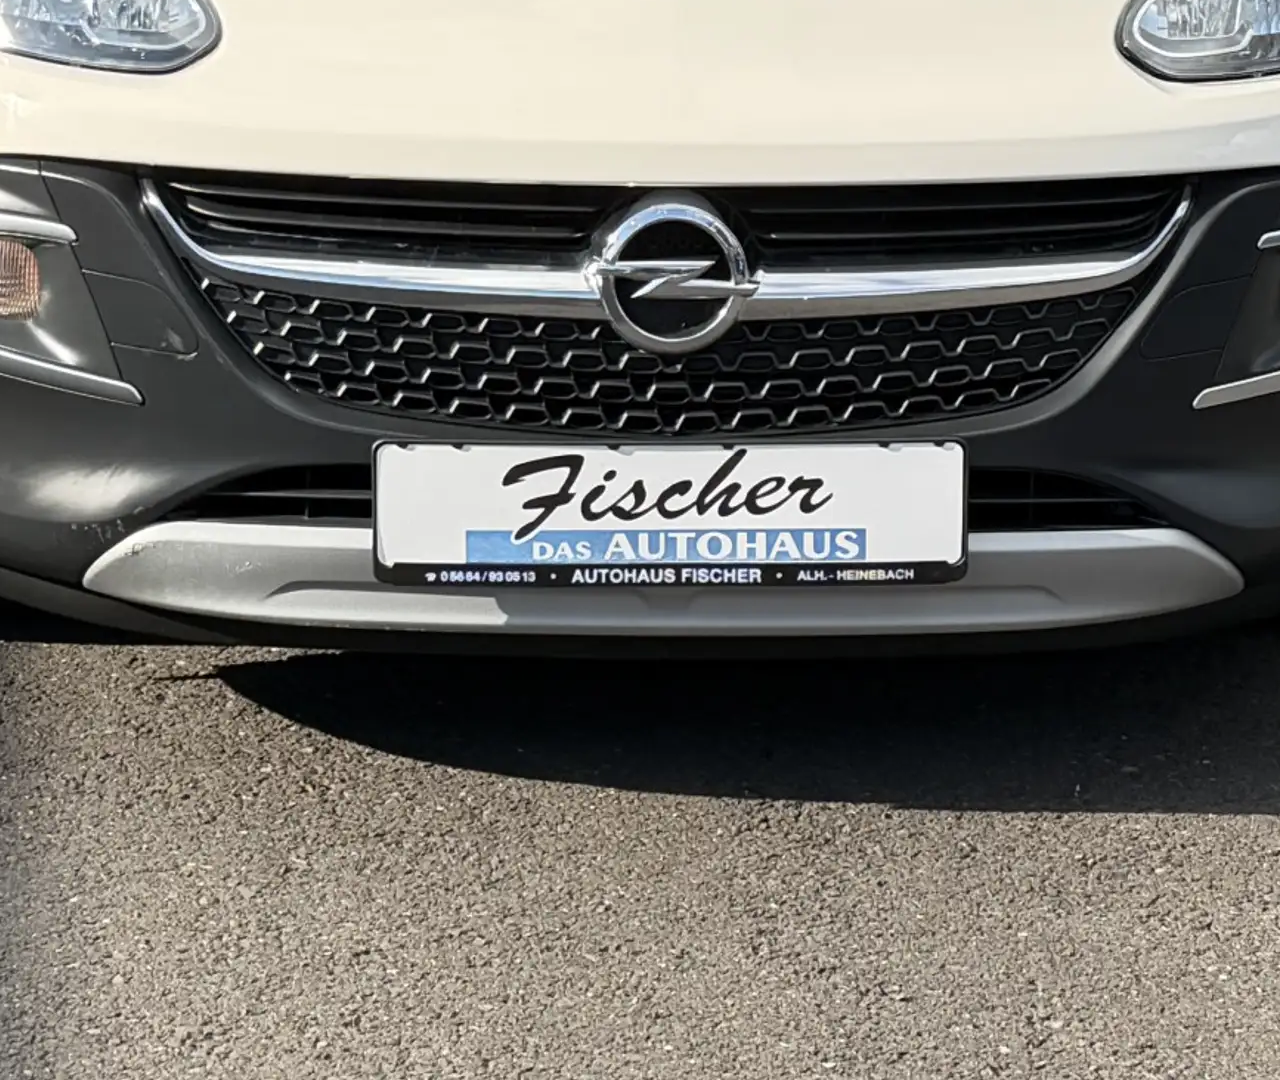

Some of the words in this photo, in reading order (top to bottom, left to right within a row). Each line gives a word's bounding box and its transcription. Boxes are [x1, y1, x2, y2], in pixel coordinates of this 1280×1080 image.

[501, 448, 834, 541] Fischer
[532, 540, 591, 561] DAS
[603, 530, 860, 561] AUTOHAUS
[571, 568, 676, 584] AUTOHAUS
[681, 568, 762, 584] FISCHER
